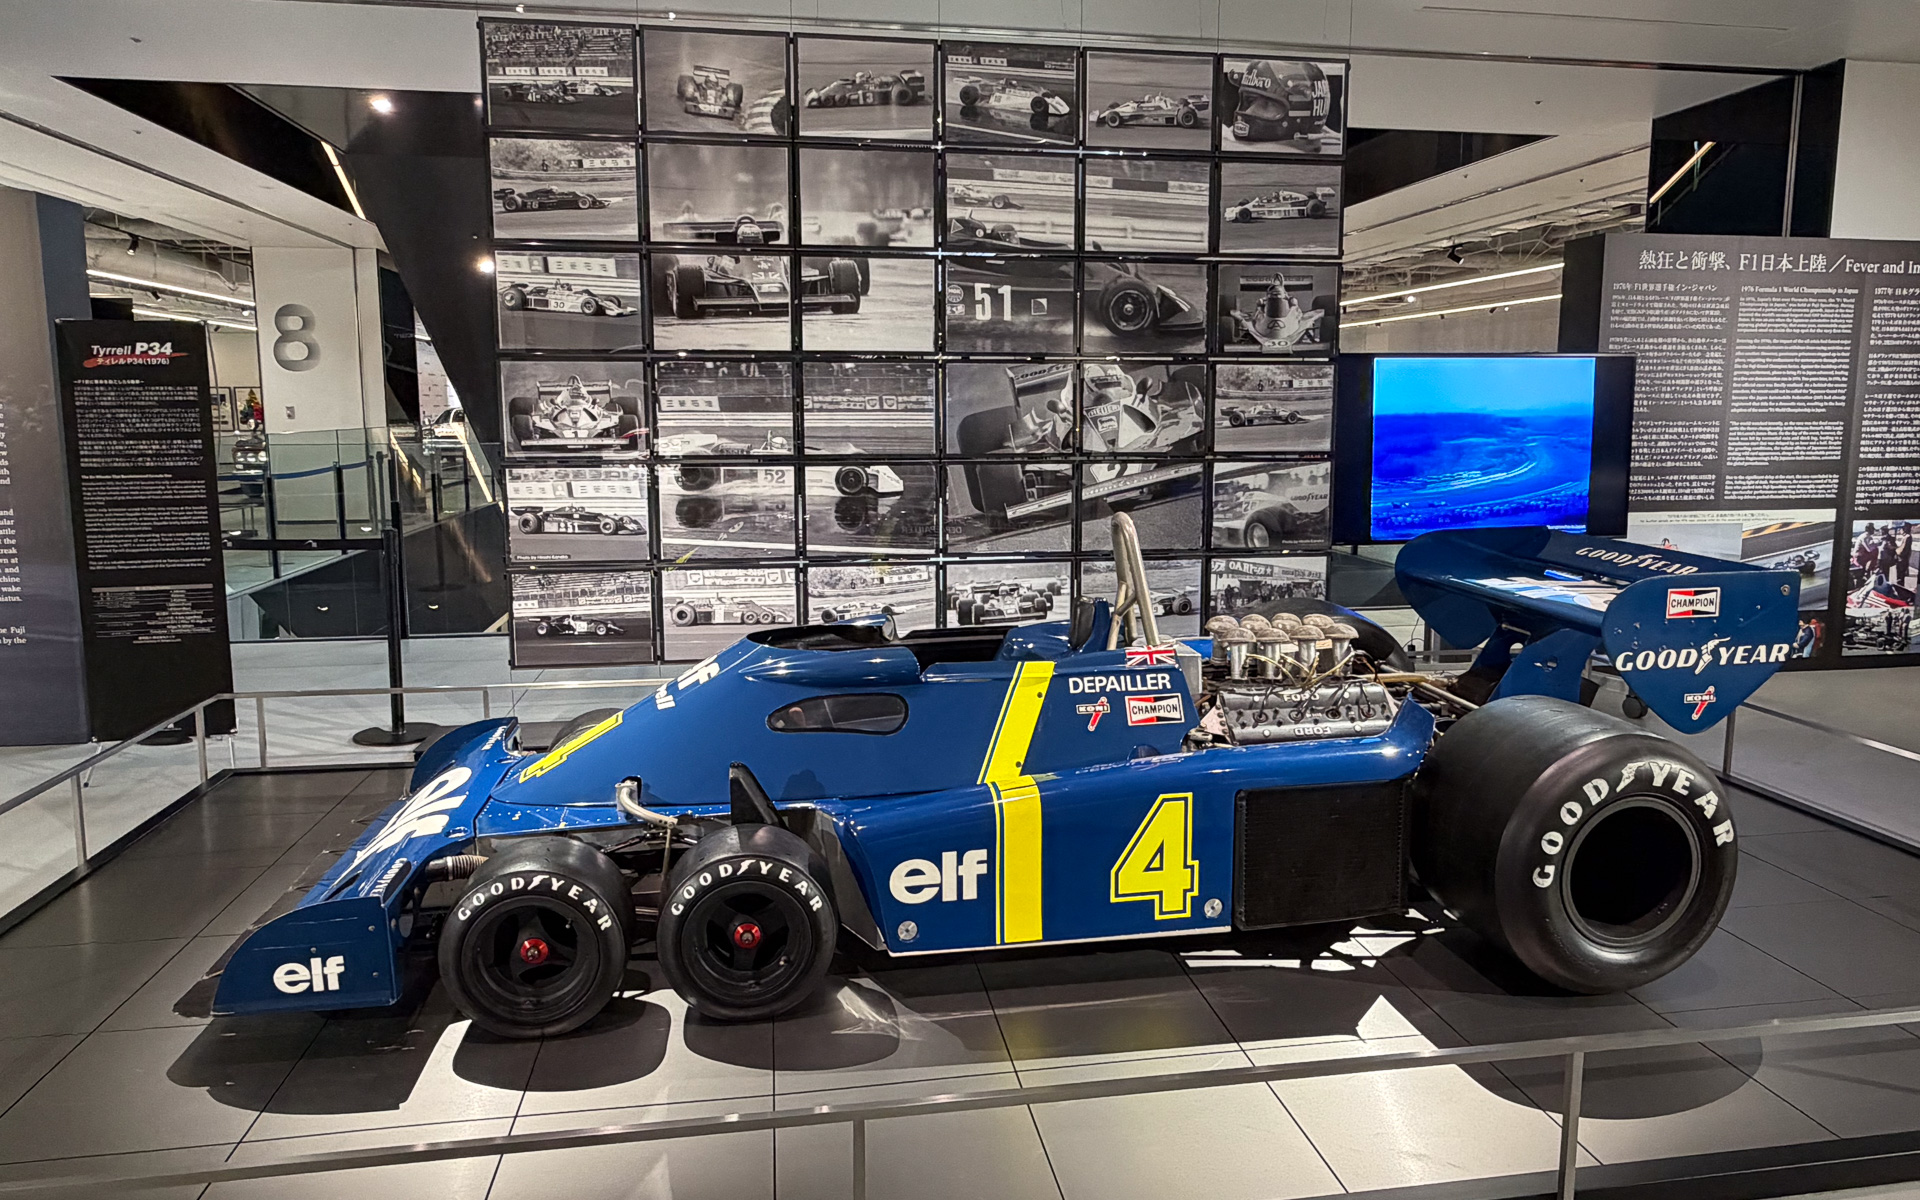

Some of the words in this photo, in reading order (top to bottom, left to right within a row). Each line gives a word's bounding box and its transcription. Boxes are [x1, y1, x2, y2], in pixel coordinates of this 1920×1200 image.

[1845, 259, 1880, 273] Fever
[1882, 260, 1905, 274] and
[973, 283, 1011, 321] 51
[273, 303, 321, 372] 8
[91, 345, 132, 357] Tyrrell
[135, 341, 173, 356] P34
[764, 469, 786, 484] 52
[4, 537, 17, 545] the
[1575, 546, 1699, 575] GOODYEAR
[1670, 597, 1715, 609] CHAMPION
[3, 637, 13, 646] by
[1615, 637, 1790, 675] GOODYEAR
[1068, 673, 1172, 694] DEPAILLER
[1283, 693, 1320, 702] FORD
[1685, 694, 1714, 702] KONI
[1078, 704, 1108, 713] KONI
[1131, 703, 1178, 716] CHAMPION
[1294, 726, 1331, 737] FORD
[1532, 761, 1735, 888] GOODYEAR
[1110, 792, 1199, 920] 4
[889, 848, 988, 904] elf
[671, 860, 824, 916] GOODYEAR
[457, 875, 613, 931] GOODYEAR
[273, 955, 345, 994] elf
